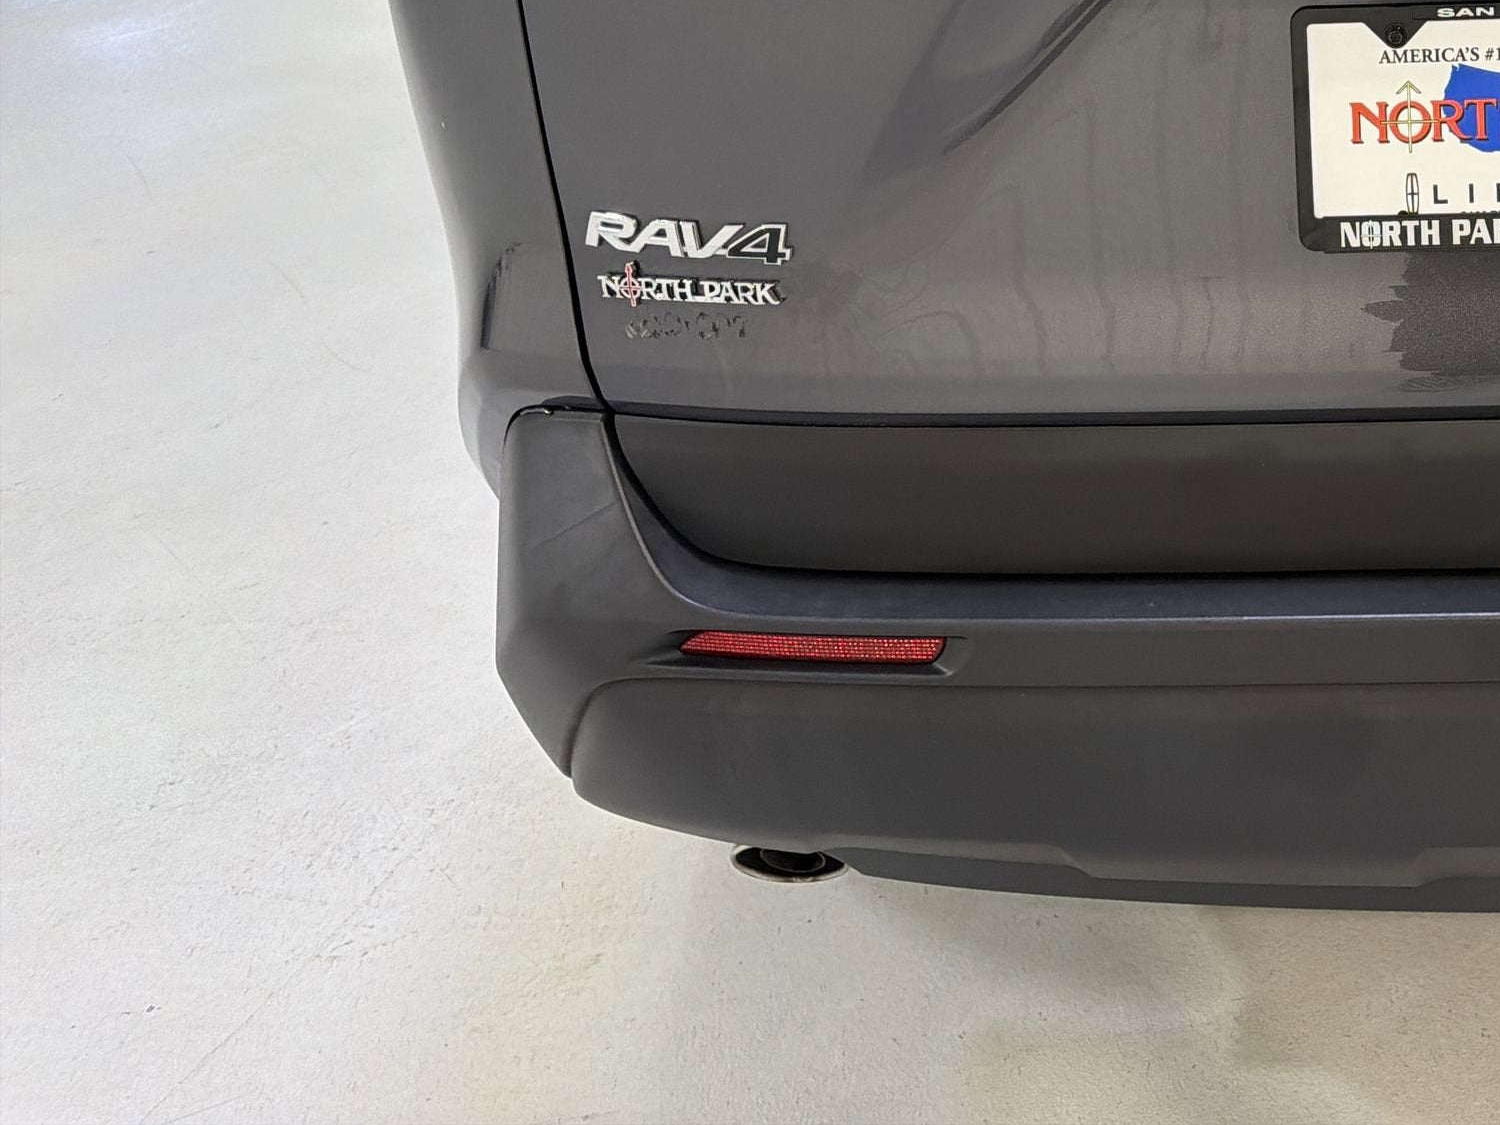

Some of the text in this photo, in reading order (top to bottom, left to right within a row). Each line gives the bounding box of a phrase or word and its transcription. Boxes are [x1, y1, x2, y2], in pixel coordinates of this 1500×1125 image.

[1437, 6, 1494, 18] SAN
[1378, 46, 1480, 64] AMERICA'S
[585, 210, 793, 266] RAV4
[1339, 219, 1441, 249] NORTH
[597, 274, 782, 305] NORTH PARK
